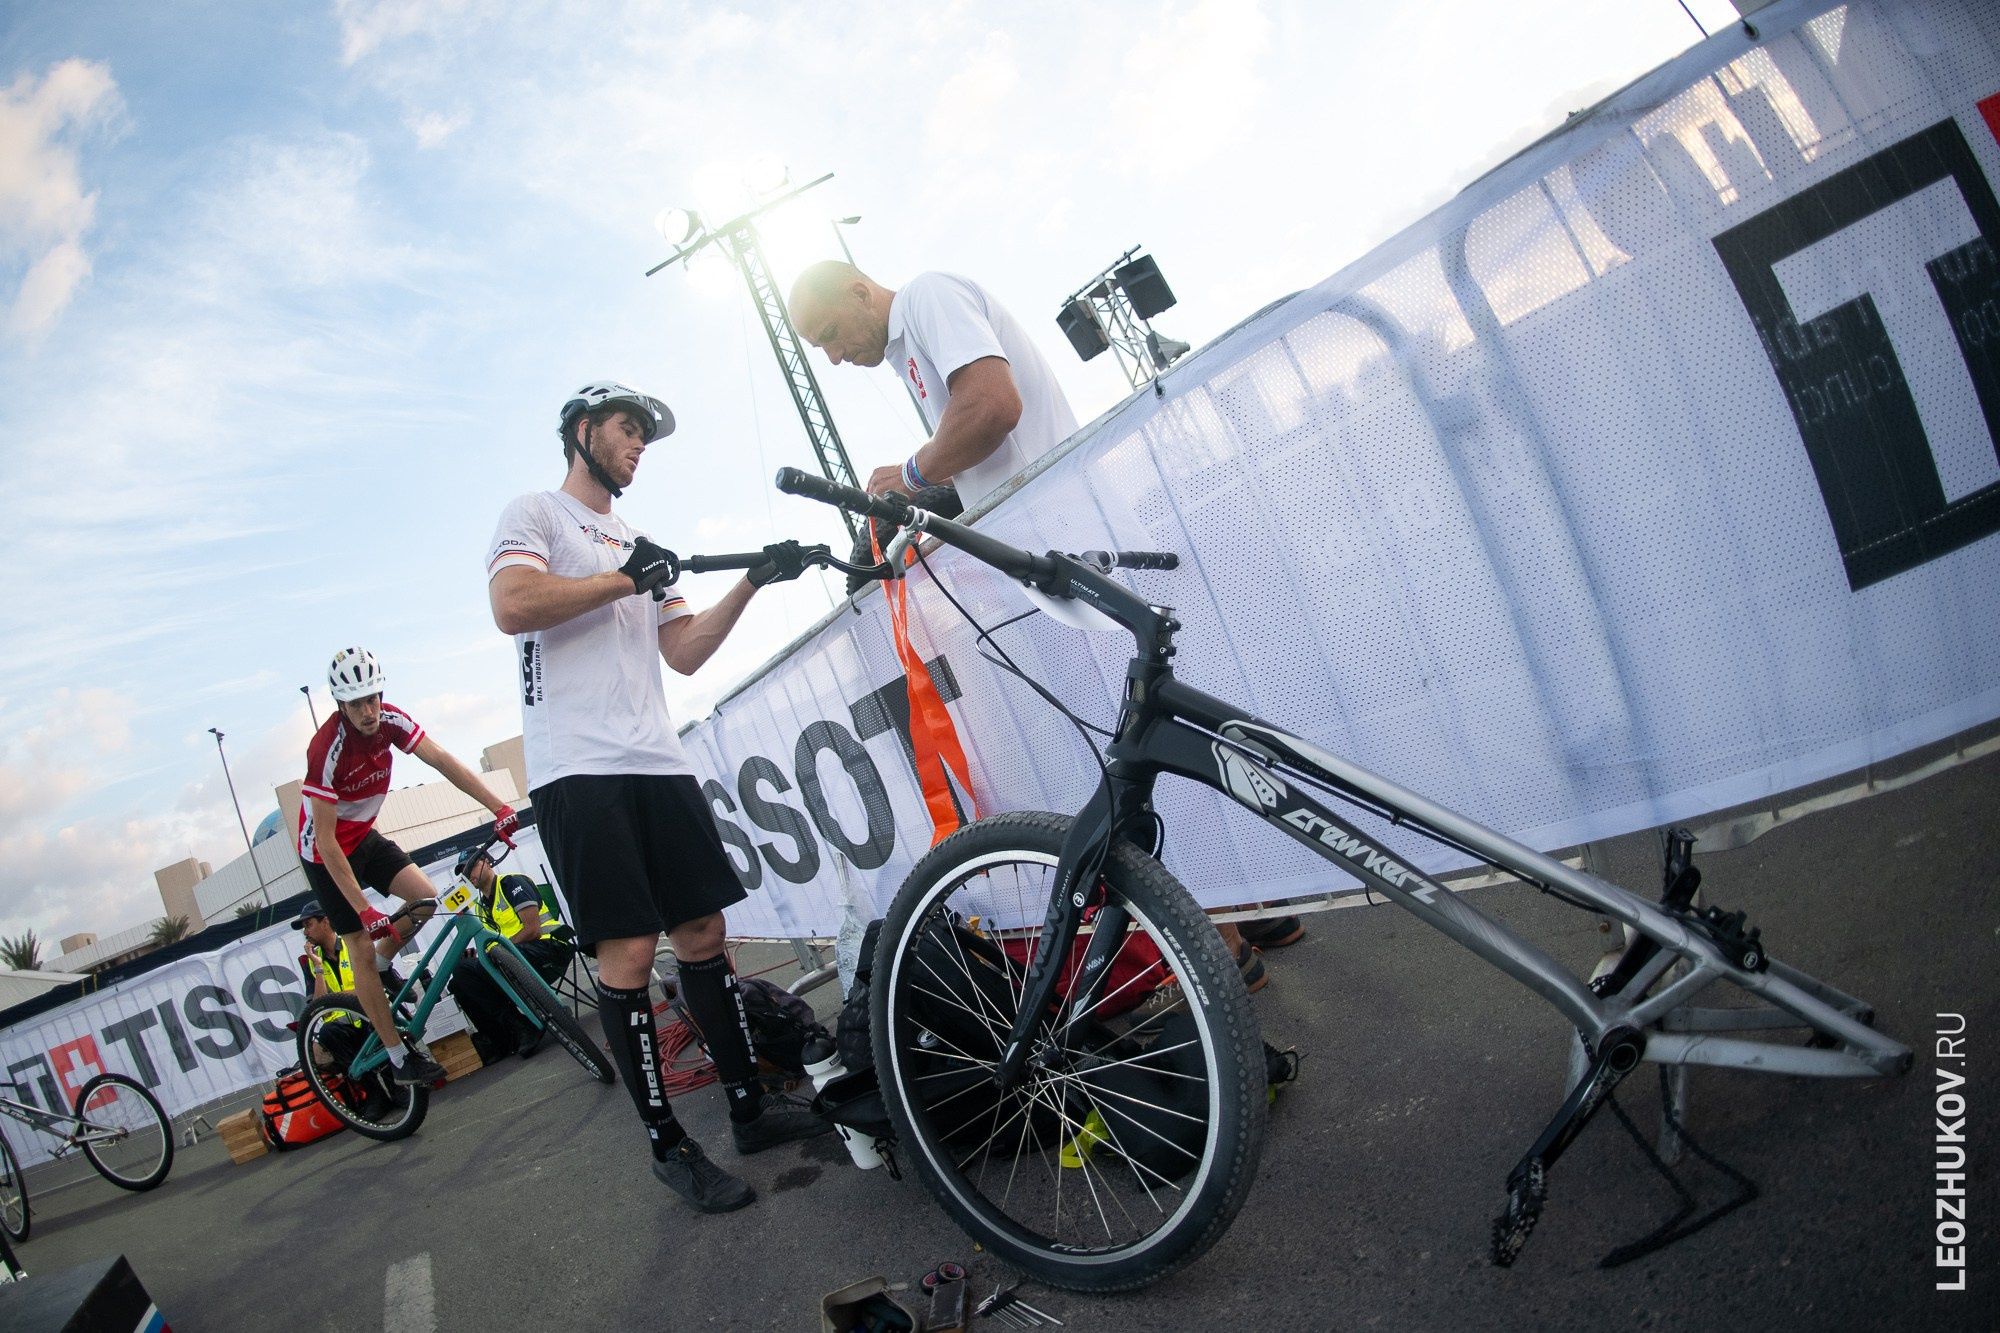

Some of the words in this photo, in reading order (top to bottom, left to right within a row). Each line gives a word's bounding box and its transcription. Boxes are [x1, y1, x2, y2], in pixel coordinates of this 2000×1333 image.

[1070, 578, 1100, 598] ULTIMATE
[522, 640, 535, 706] KTM
[702, 653, 966, 890] SSOT
[450, 890, 465, 907] 15
[1056, 868, 1072, 908] ULTIMATE
[1086, 955, 1105, 972] WAW
[100, 965, 307, 1090] TISS
[639, 1033, 663, 1107] hebo
